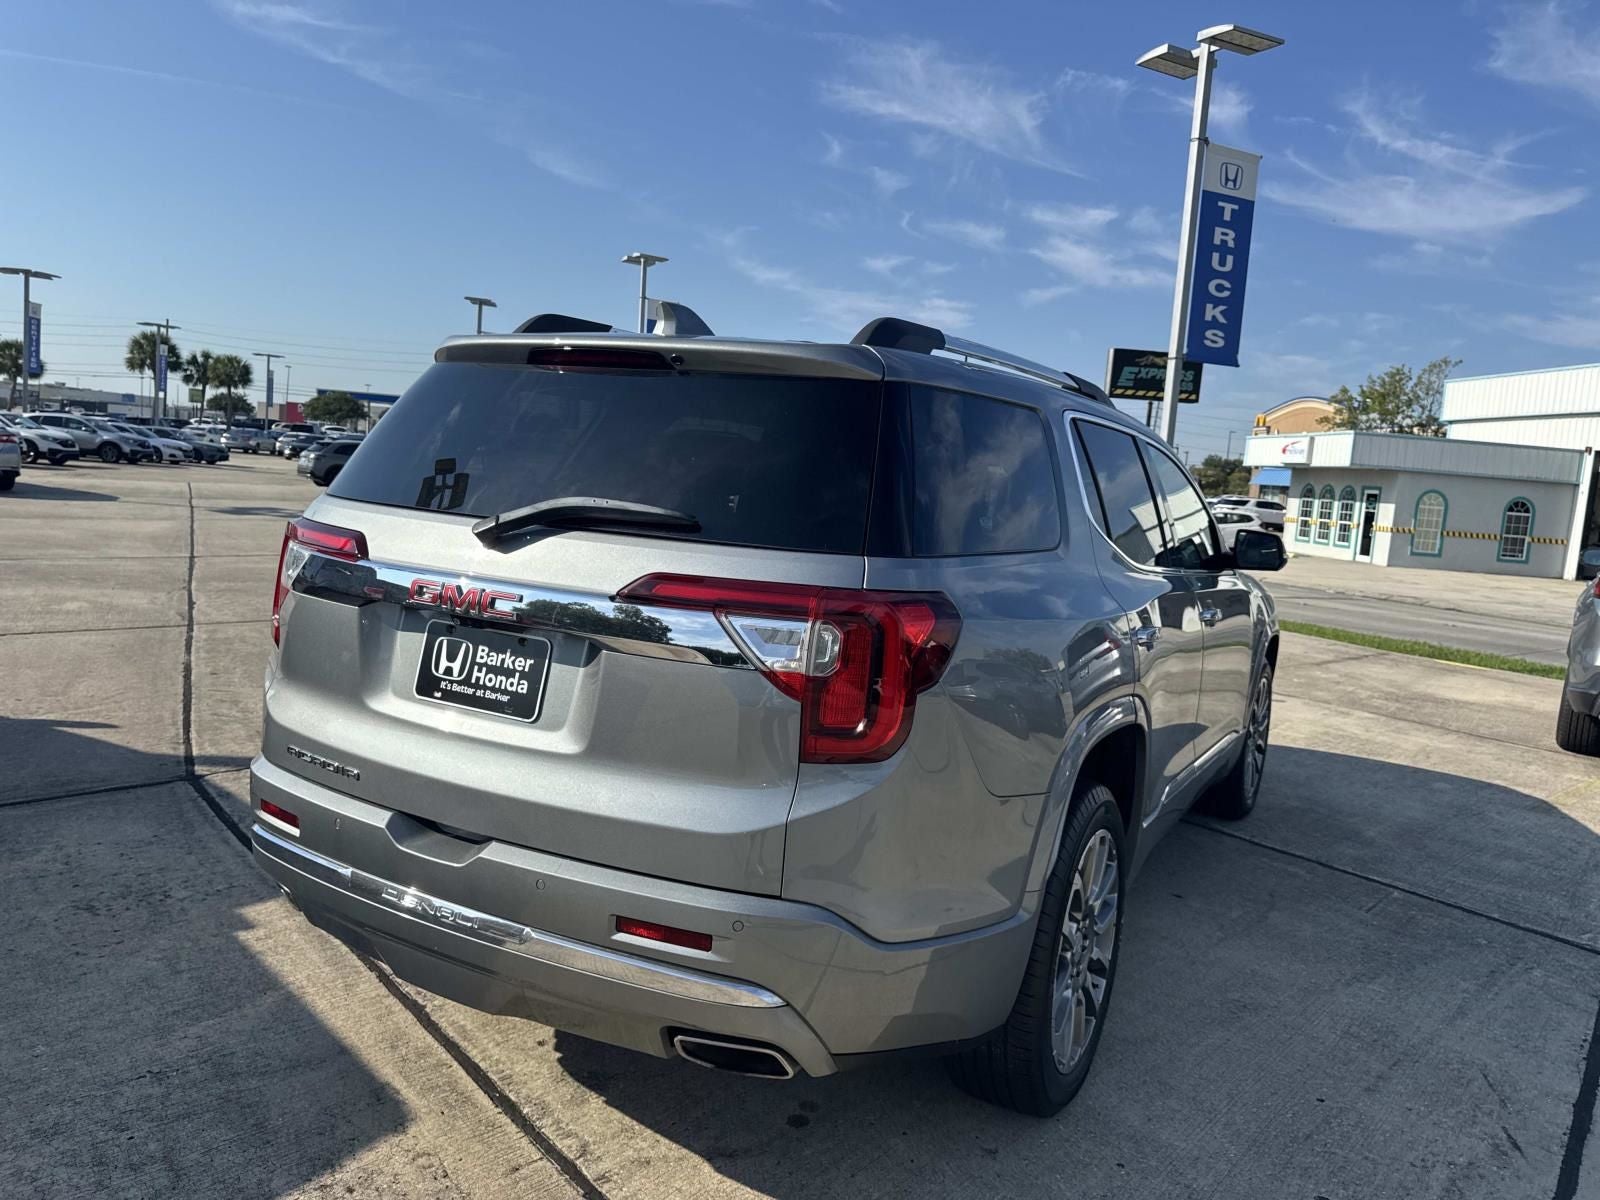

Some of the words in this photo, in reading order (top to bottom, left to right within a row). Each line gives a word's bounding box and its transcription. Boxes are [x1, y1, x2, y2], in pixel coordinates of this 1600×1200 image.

[1203, 201, 1239, 348] TRUCKS
[1117, 366, 1195, 386] EXPRSS
[408, 578, 523, 620] GMC
[475, 644, 534, 672] Barker
[440, 680, 451, 690] It's
[451, 683, 476, 695] Better
[475, 688, 485, 697] at
[485, 690, 511, 702] Barker
[471, 665, 528, 694] Honda
[287, 744, 360, 781] ACADIA
[382, 886, 480, 928] DENALI
